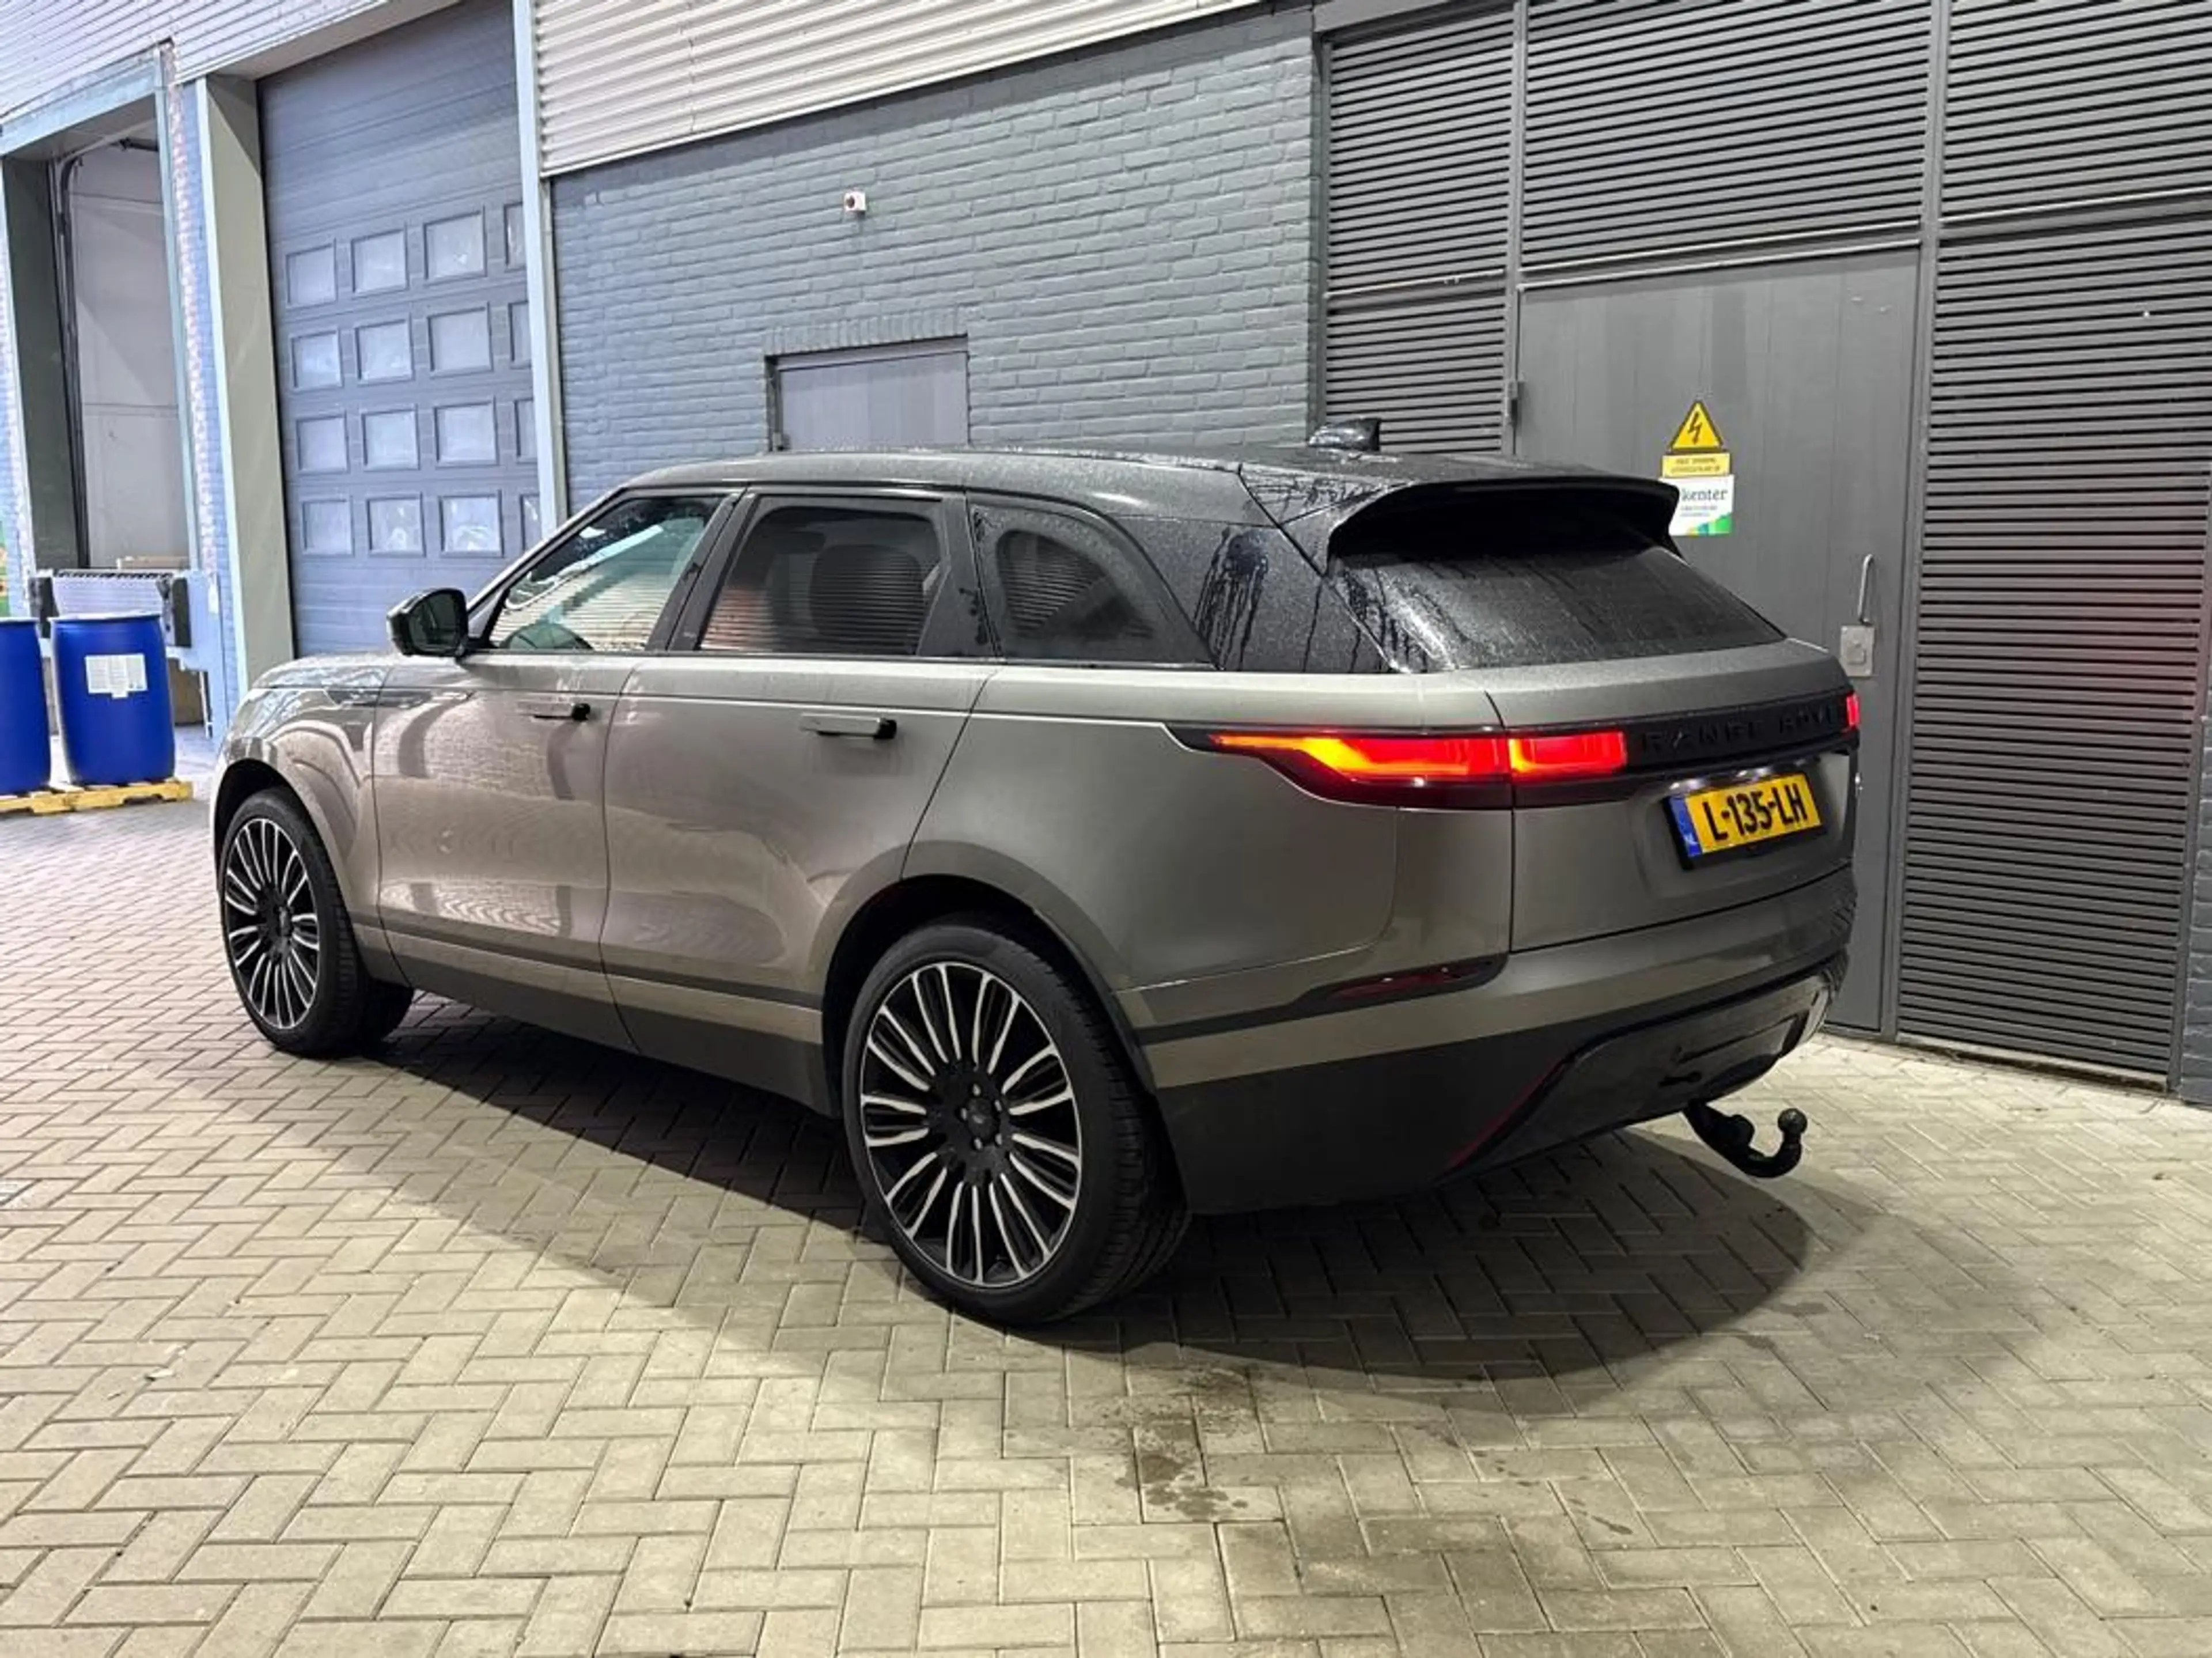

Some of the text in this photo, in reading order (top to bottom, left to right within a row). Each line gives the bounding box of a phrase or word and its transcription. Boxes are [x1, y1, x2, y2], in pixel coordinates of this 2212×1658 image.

[1681, 488, 1728, 502] kenter
[1642, 704, 1838, 752] RANGE ROVE
[1702, 782, 1809, 841] L-135-LH
